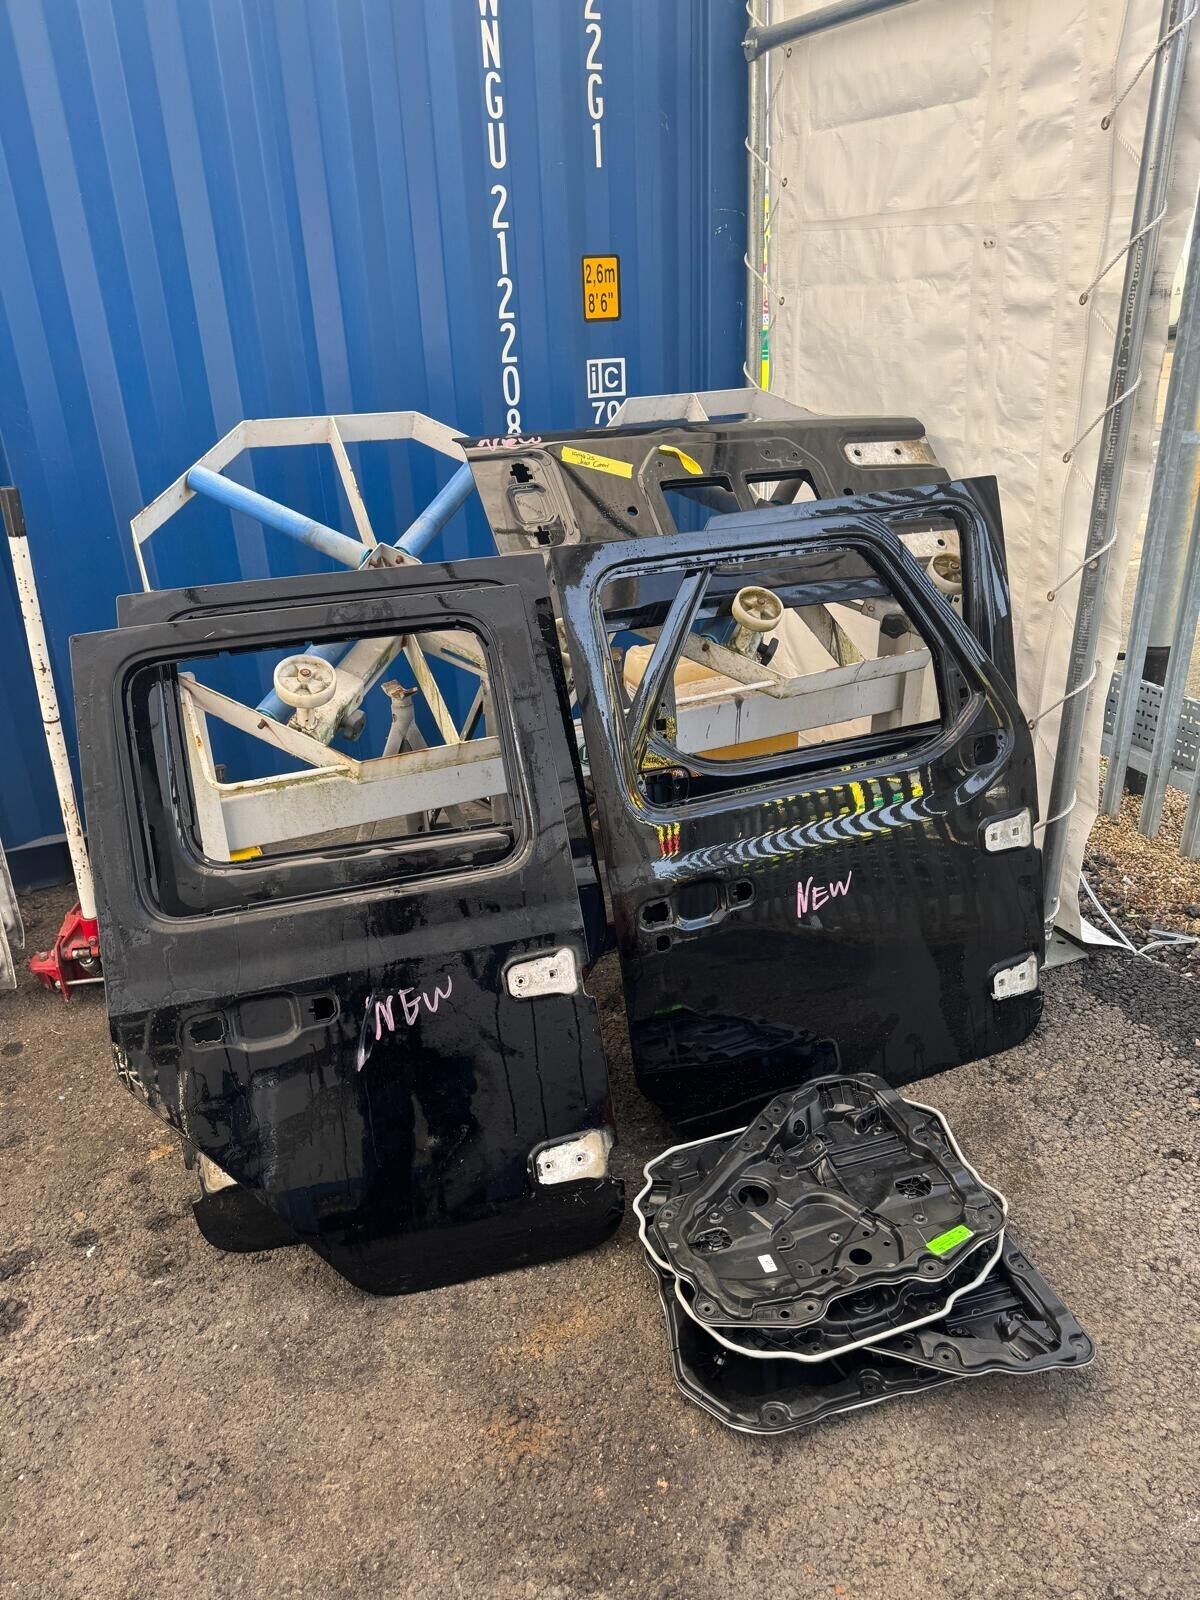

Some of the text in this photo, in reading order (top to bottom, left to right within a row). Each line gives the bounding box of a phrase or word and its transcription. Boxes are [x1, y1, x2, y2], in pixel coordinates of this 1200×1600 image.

[586, 264, 616, 287] 2,6m
[588, 292, 614, 313] 8'6"
[797, 870, 852, 918] NEW
[374, 975, 453, 1041] NEW
